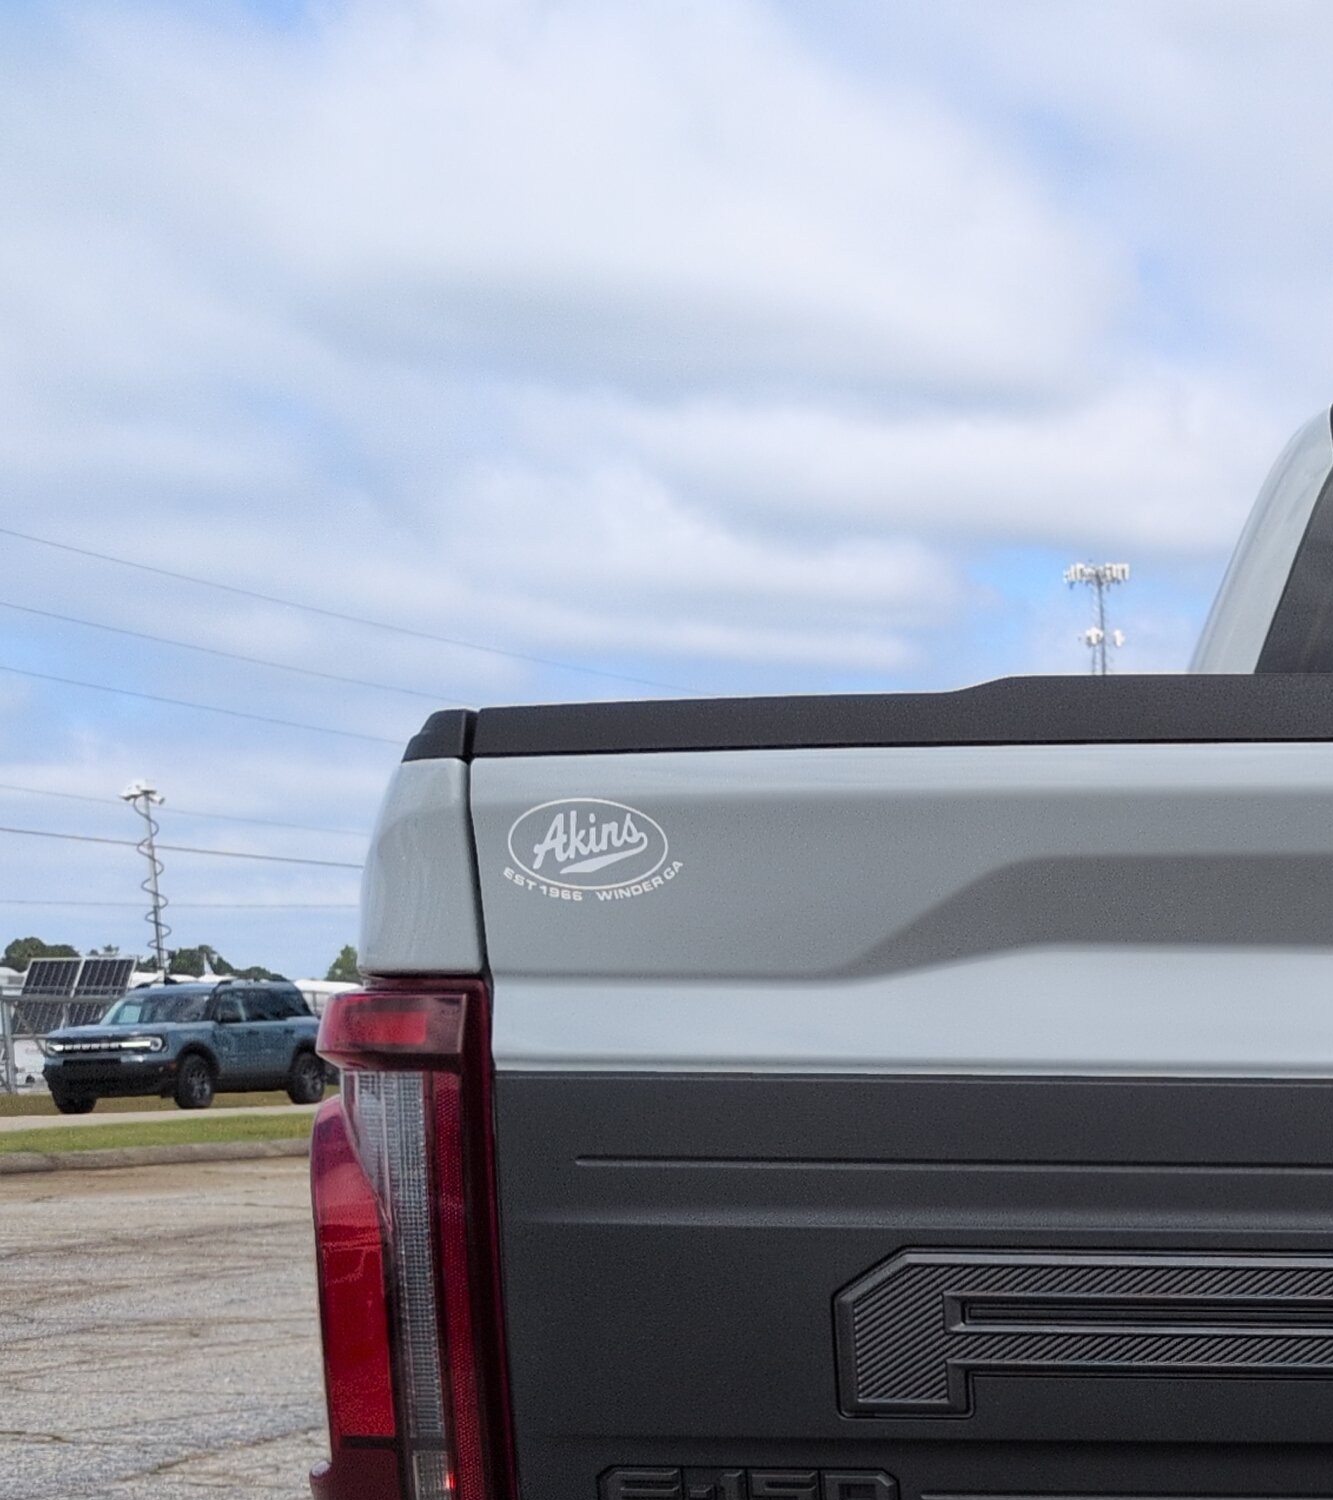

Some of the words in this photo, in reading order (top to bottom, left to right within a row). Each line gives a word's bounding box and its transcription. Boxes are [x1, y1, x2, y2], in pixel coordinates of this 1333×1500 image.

[533, 811, 647, 870] Akins
[503, 867, 537, 890] EST
[595, 876, 664, 901] WINDER
[663, 861, 683, 880] GA
